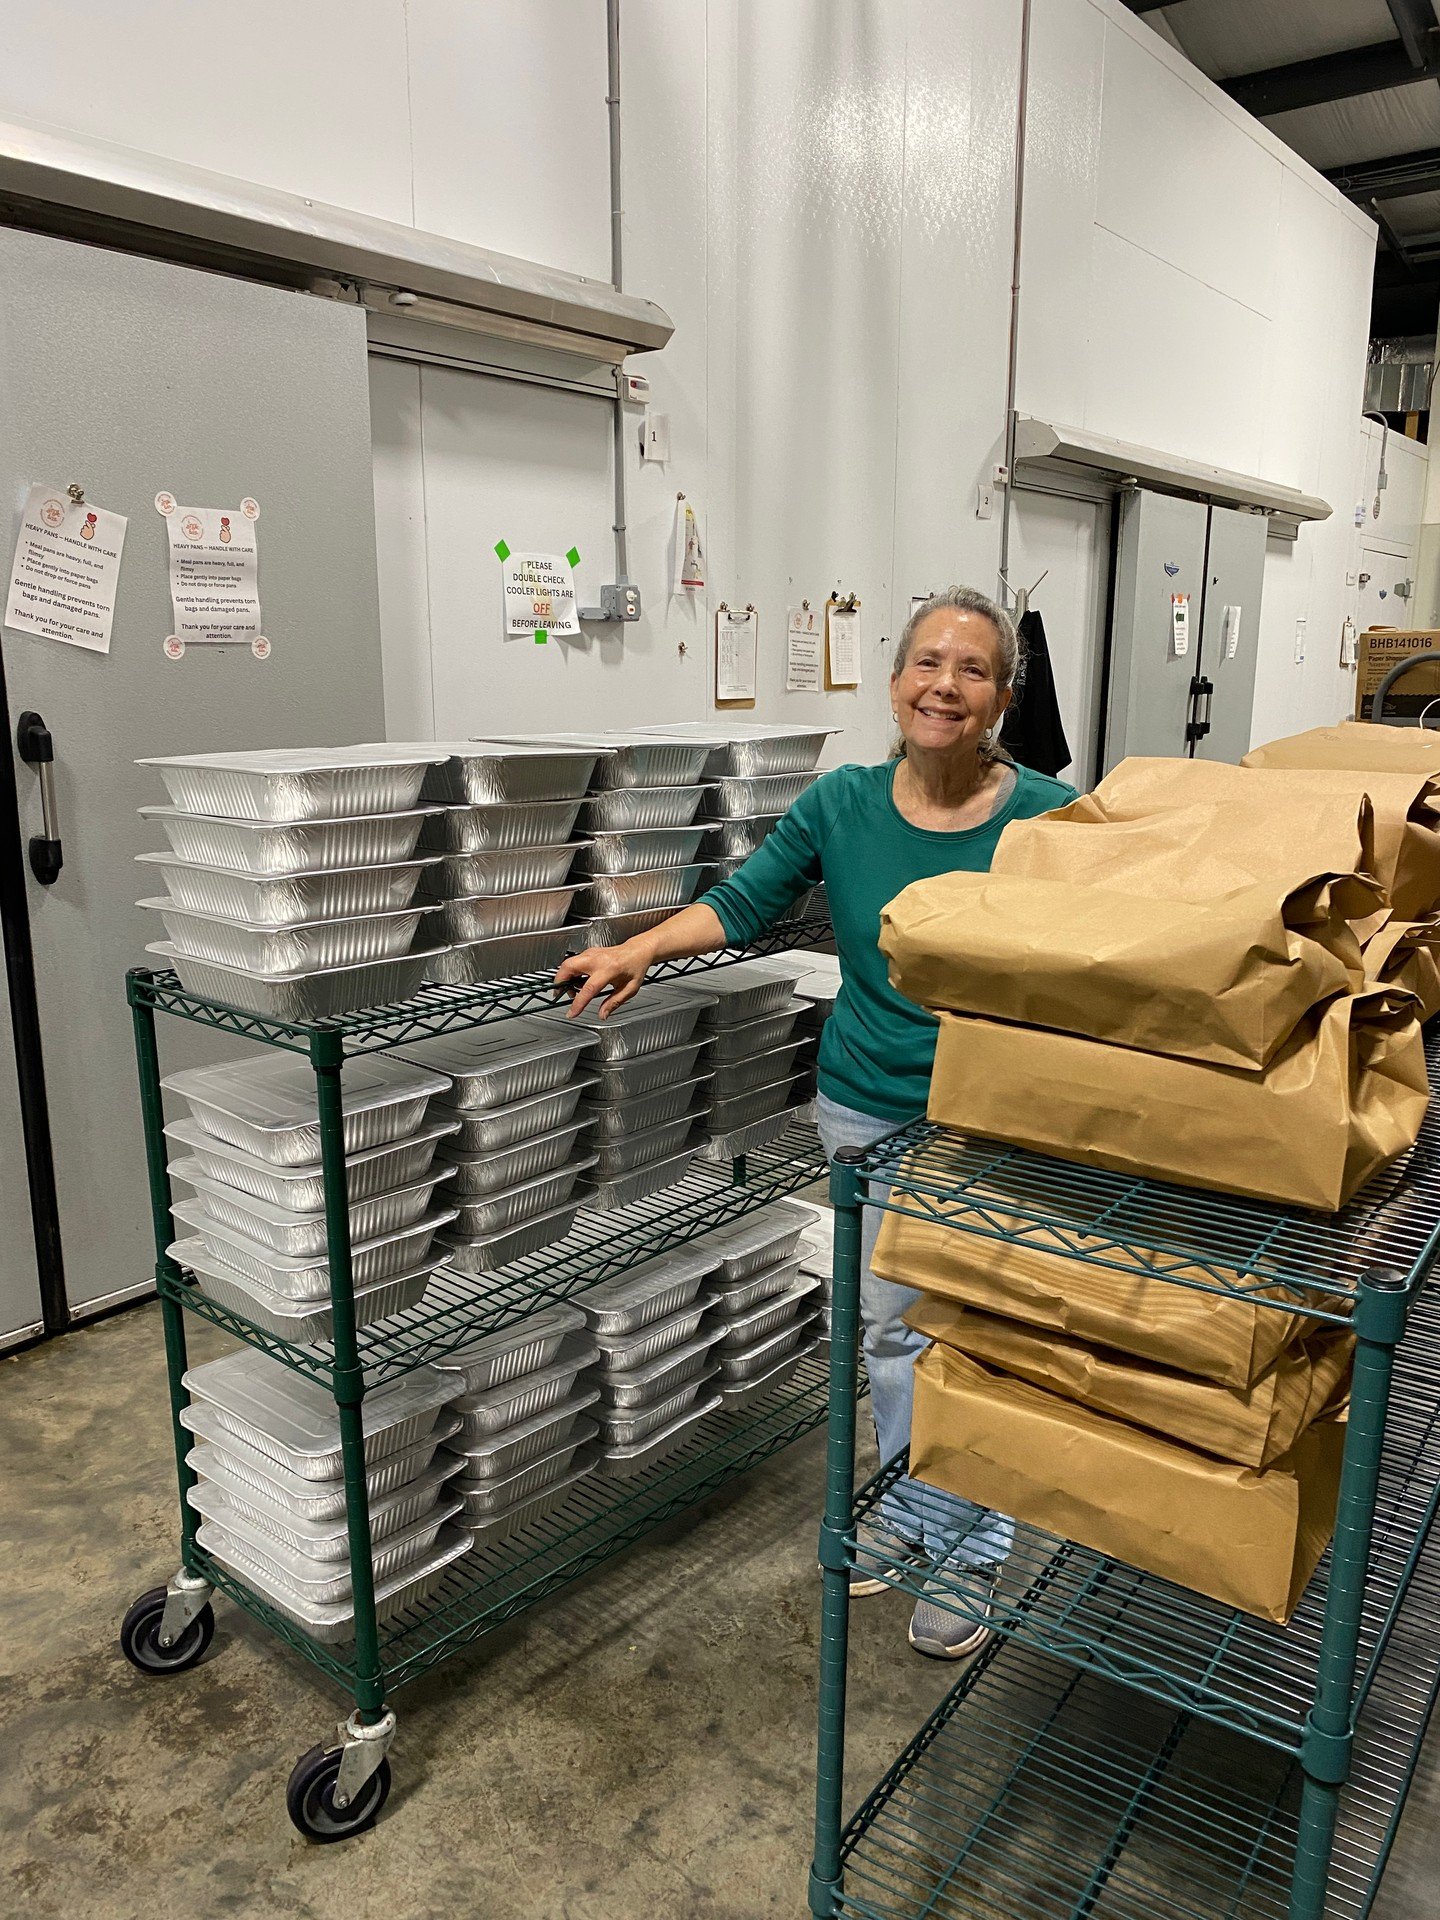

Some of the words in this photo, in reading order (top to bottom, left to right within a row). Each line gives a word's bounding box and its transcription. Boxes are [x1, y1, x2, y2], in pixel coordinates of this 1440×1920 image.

[651, 431, 656, 442] 1
[984, 496, 989, 504] 2
[25, 523, 43, 533] HEAVY
[44, 529, 58, 538] PANS
[64, 537, 86, 548] HANDLE
[88, 544, 101, 553] WITH
[103, 550, 117, 558] CARE
[30, 542, 42, 550] Meal
[43, 546, 55, 554] pans
[66, 553, 81, 563] heavy,
[83, 559, 92, 567] full,
[27, 557, 41, 566] Place
[42, 563, 58, 572] gently
[71, 572, 85, 581] paper
[527, 561, 552, 570] PLEASE
[44, 570, 56, 579] drop
[64, 577, 78, 585] force
[513, 573, 541, 582] DOUBLE
[543, 575, 565, 584] CHECK
[14, 578, 36, 590] Gentle
[38, 585, 66, 600] handling
[67, 595, 95, 608] prevents
[97, 603, 110, 611] torn
[507, 586, 535, 595] COOLER
[536, 588, 560, 597] LIGHTS
[561, 590, 573, 598] ARE
[22, 591, 38, 600] bags
[39, 596, 51, 604] and
[52, 599, 82, 613] damaged
[83, 609, 100, 618] pans.
[533, 603, 550, 615] OFF
[14, 608, 34, 619] Thank
[35, 615, 47, 623] you
[48, 618, 58, 626] for
[59, 621, 75, 630] your
[76, 626, 90, 634] care
[91, 630, 103, 638] and
[540, 620, 571, 628] LEAVING
[42, 626, 73, 640] attention.
[1370, 638, 1432, 648] BHB141016
